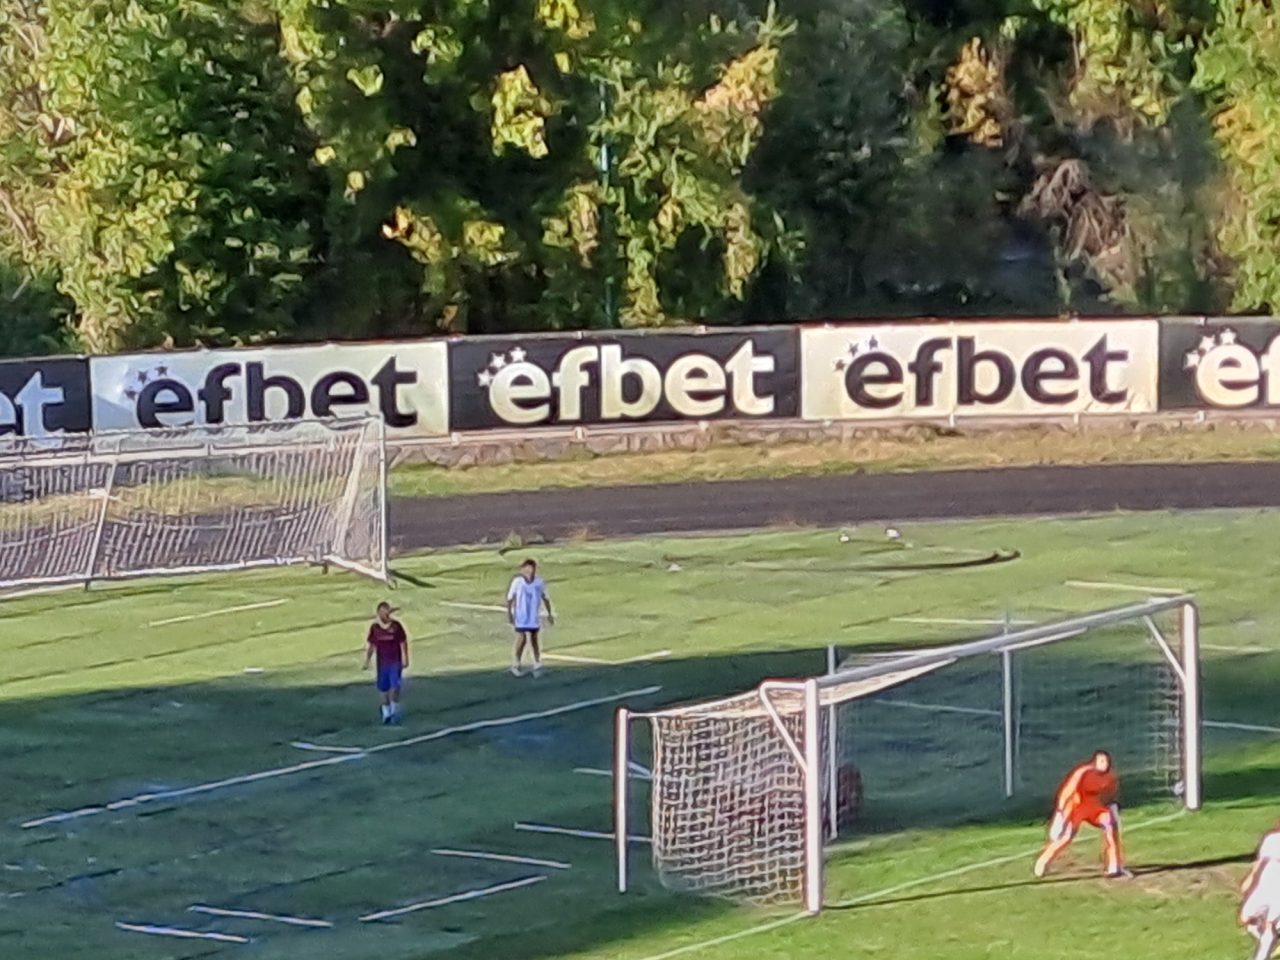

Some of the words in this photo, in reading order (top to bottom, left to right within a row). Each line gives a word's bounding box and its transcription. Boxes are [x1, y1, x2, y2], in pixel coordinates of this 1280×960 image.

[136, 356, 418, 430] efbet
[488, 339, 775, 424] efbet
[844, 333, 1128, 408] efbet
